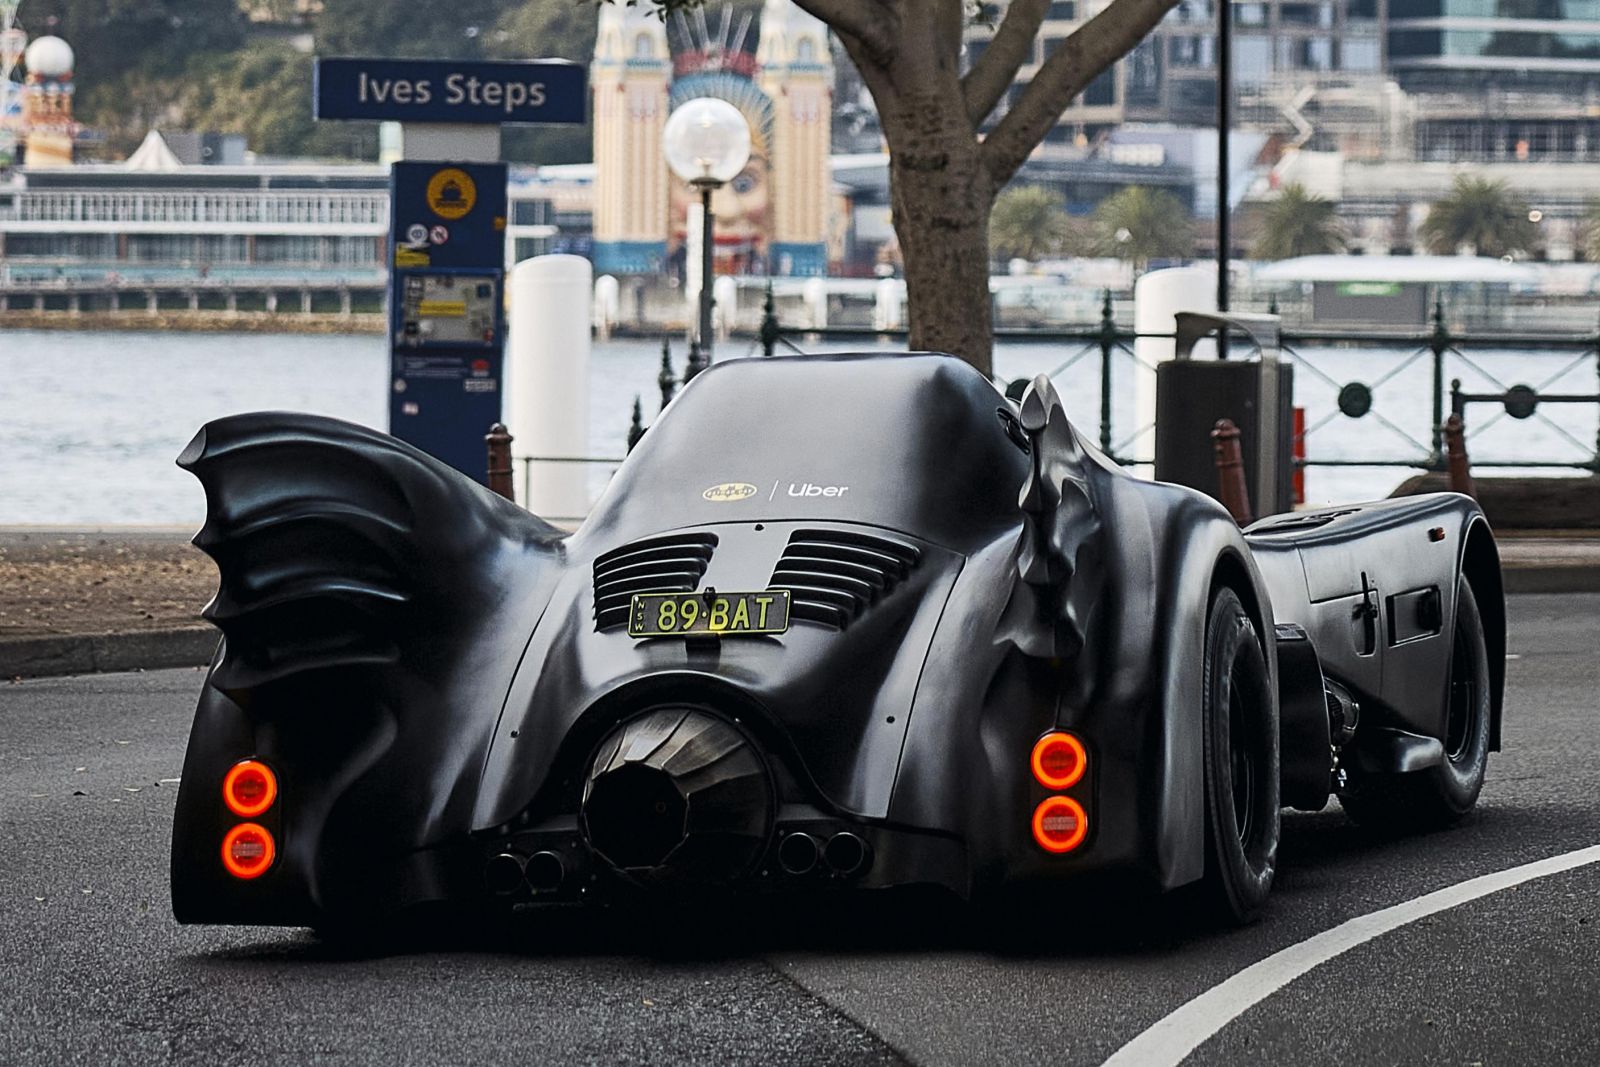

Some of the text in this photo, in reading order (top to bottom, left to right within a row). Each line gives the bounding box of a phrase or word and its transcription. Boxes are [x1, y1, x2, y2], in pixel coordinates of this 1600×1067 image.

[359, 72, 546, 113] Ives Steps
[788, 483, 848, 497] Uber
